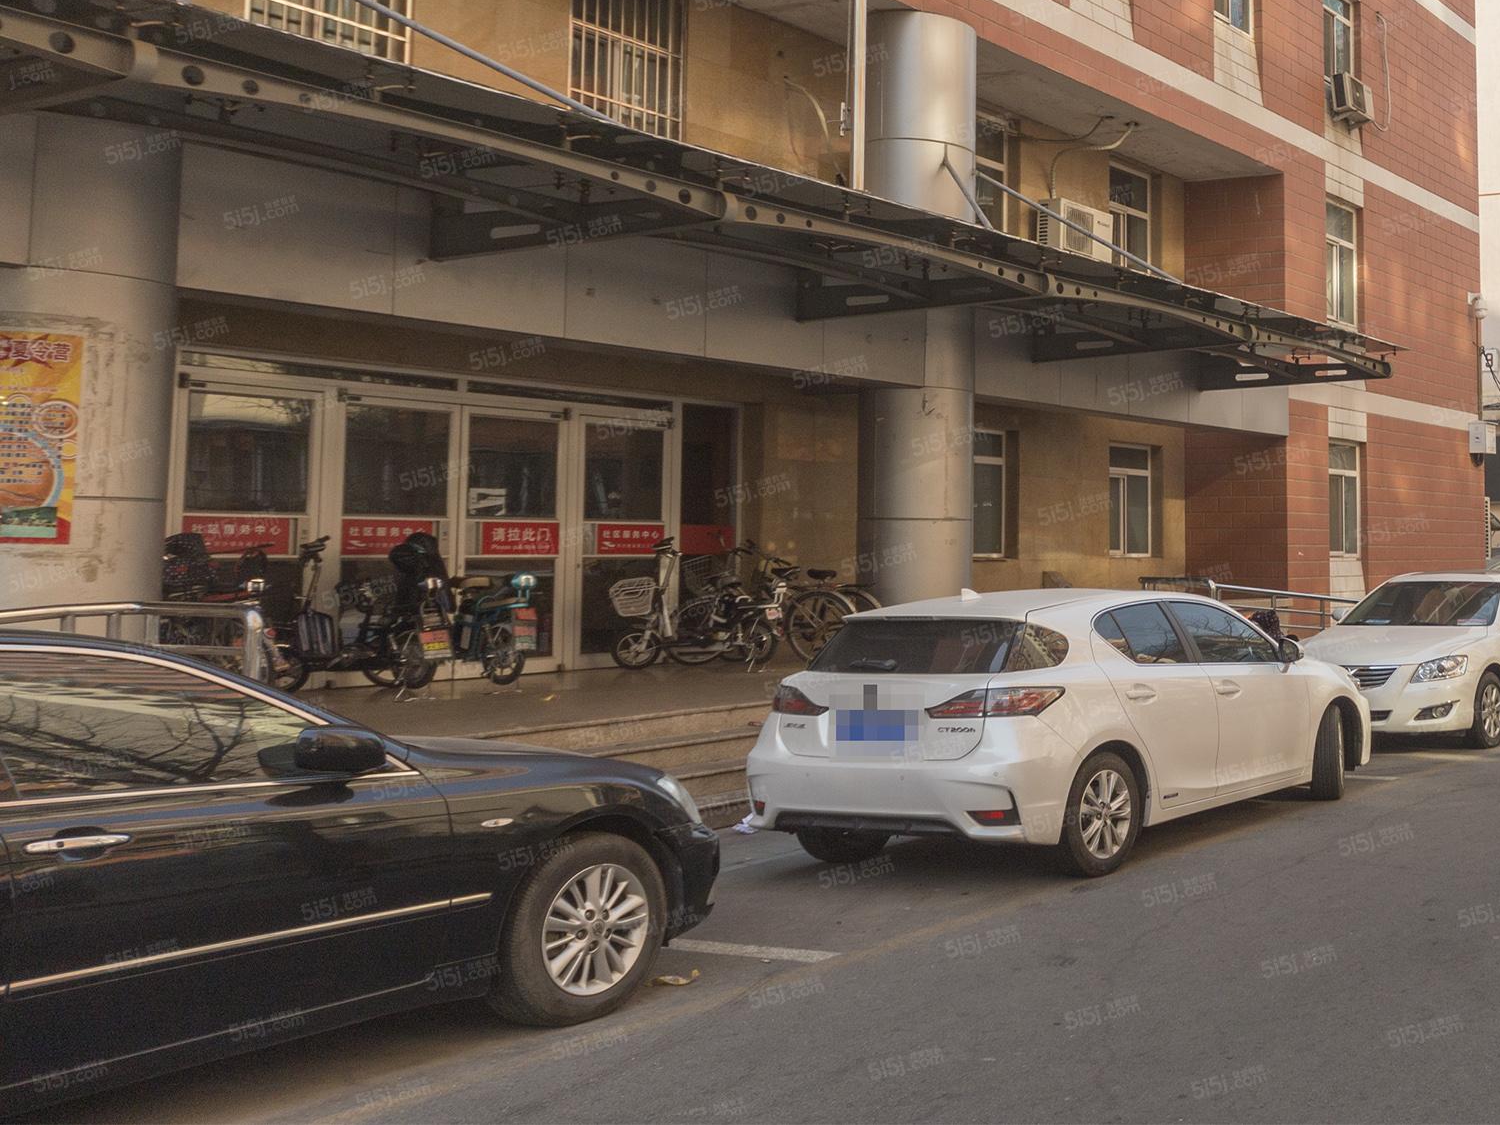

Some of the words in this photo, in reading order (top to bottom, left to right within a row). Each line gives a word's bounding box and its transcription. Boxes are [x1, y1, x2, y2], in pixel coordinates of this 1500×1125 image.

[191, 523, 281, 536] 社区服务中心
[491, 527, 551, 542] 请拉此门
[602, 530, 660, 539] 社区服务中心
